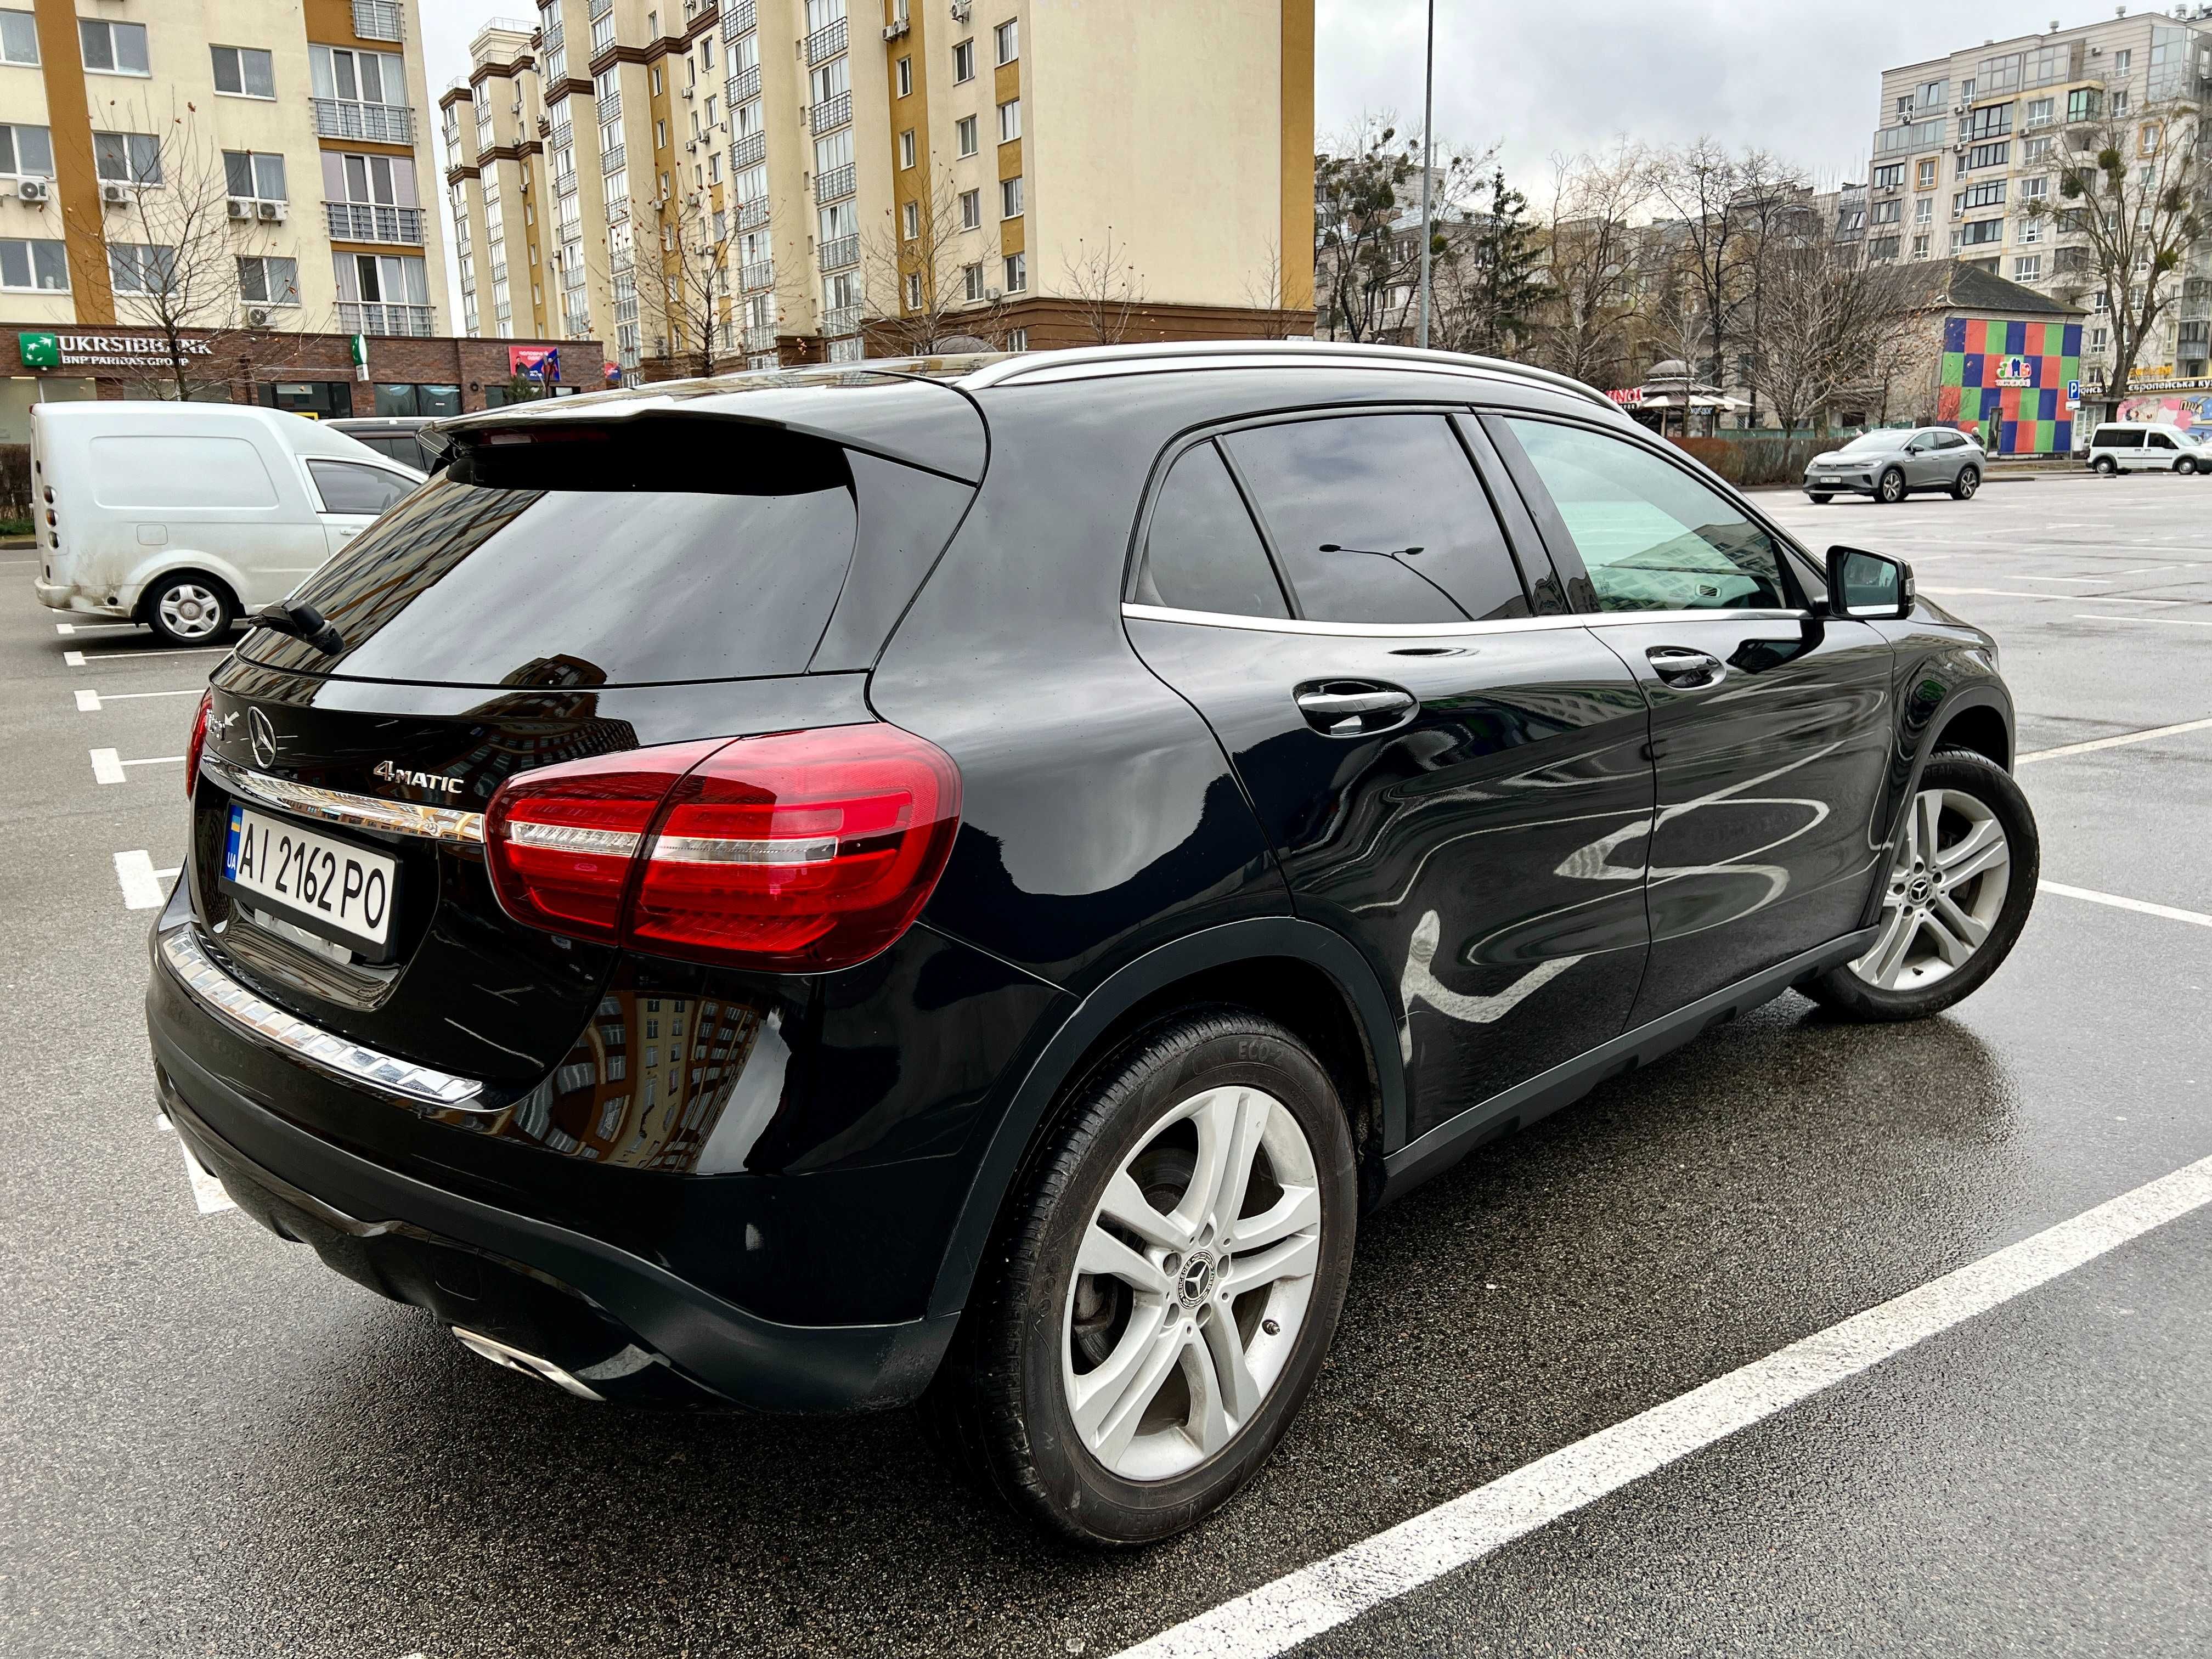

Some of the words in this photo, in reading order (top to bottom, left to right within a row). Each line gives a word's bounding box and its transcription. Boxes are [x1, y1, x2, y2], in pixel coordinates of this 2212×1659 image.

[62, 356, 88, 364] BNP
[91, 356, 144, 365] PARIBAS
[147, 357, 189, 366] GROP
[2070, 382, 2077, 398] P
[373, 760, 464, 794] 4MATIC
[227, 852, 236, 871] UA
[239, 823, 269, 884] AI
[275, 836, 336, 912] 2162
[340, 859, 386, 929] PO
[1178, 1260, 1192, 1299] MERCEDES
